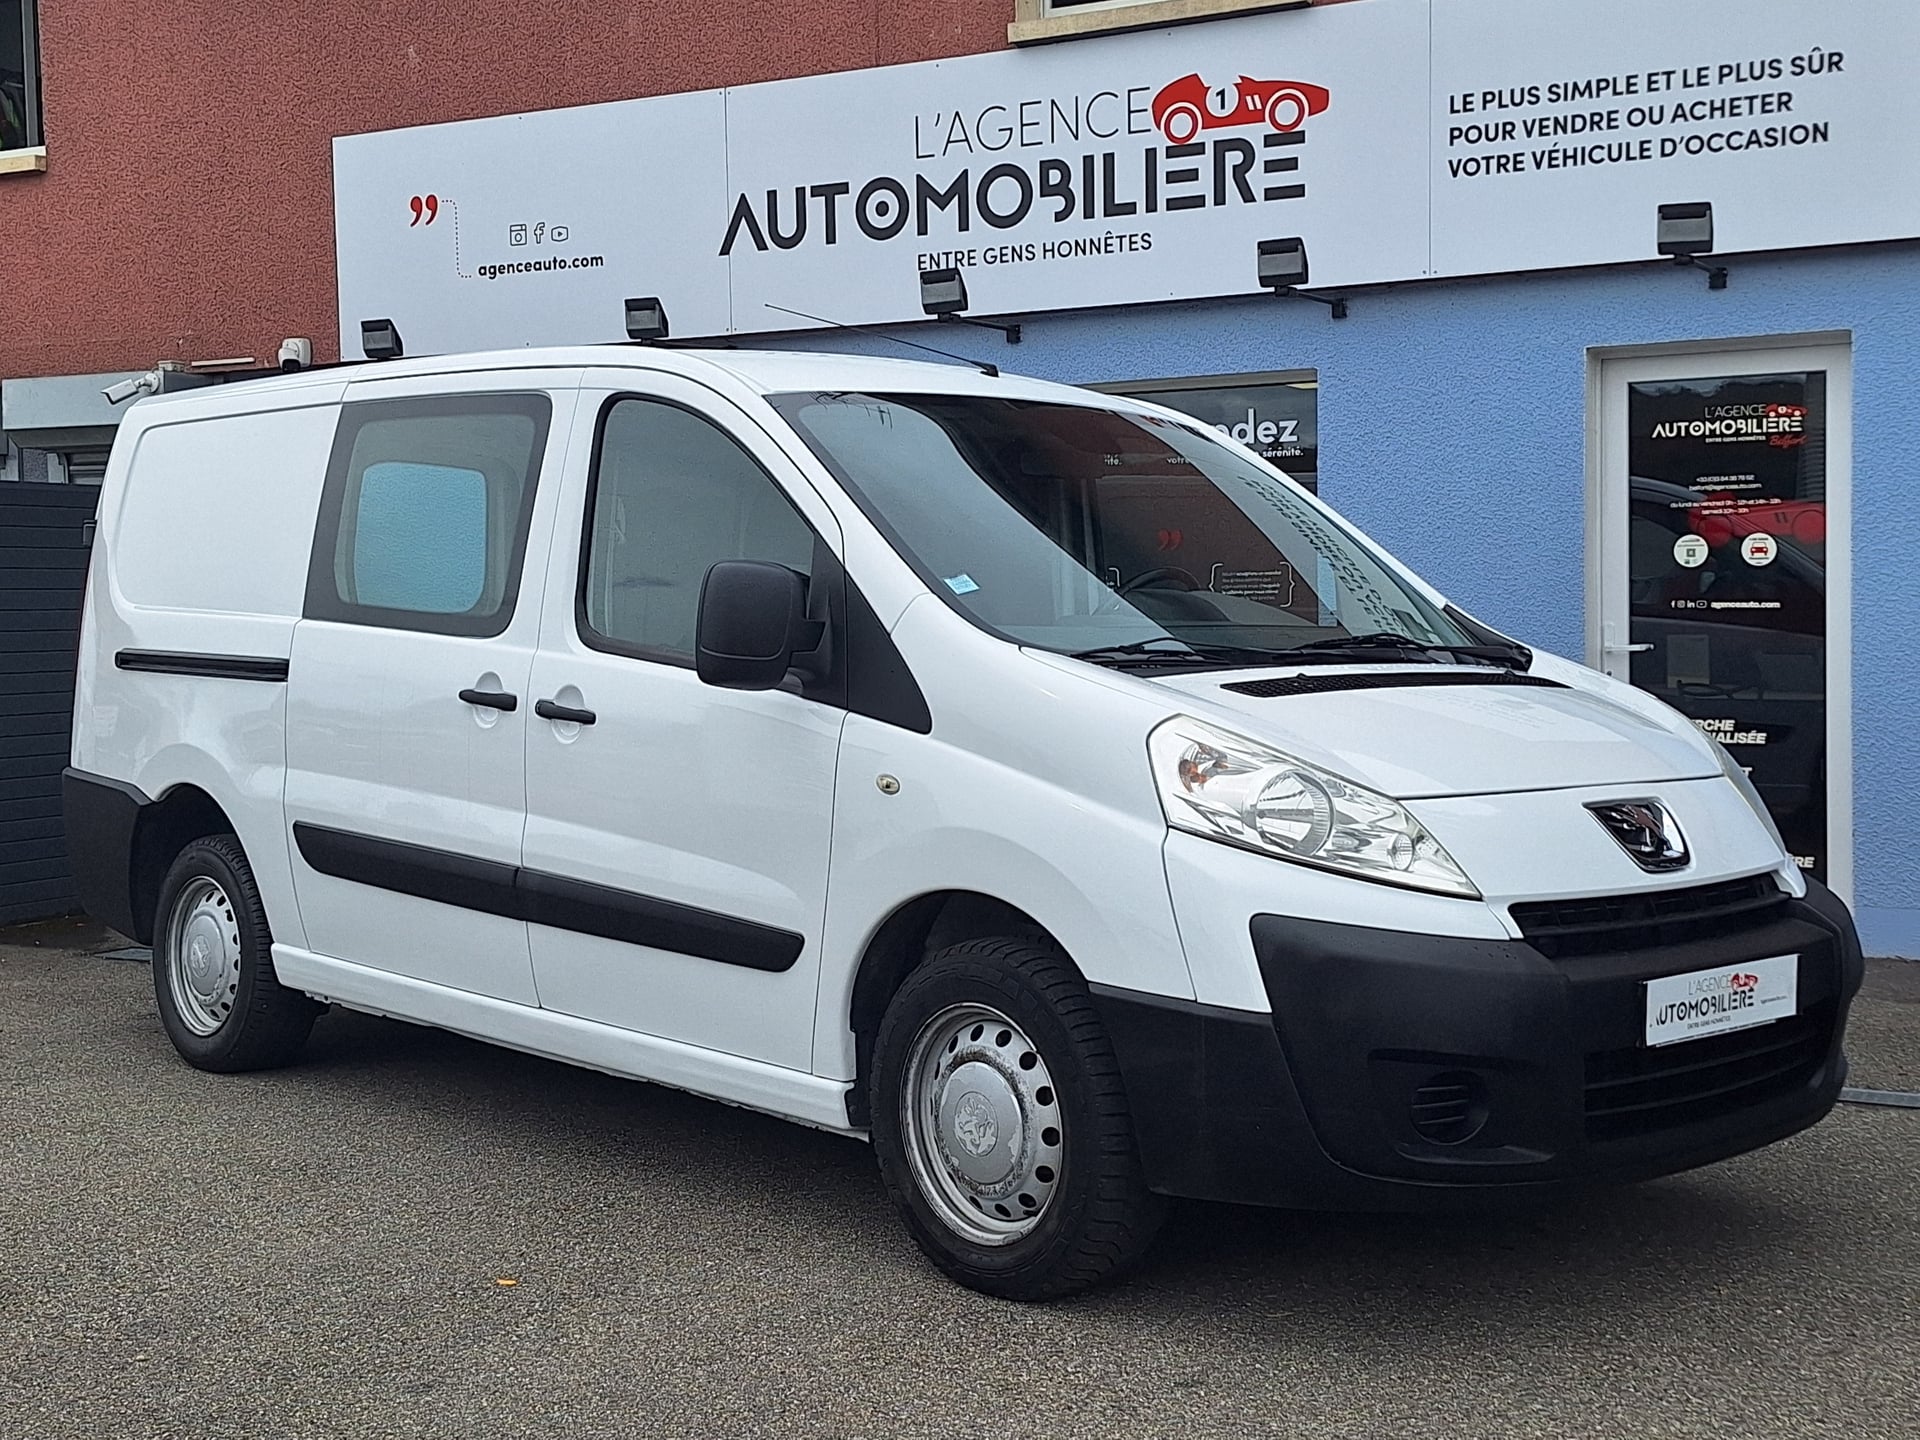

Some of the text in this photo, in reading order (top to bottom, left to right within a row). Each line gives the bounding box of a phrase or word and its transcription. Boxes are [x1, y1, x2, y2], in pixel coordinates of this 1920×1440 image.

[1449, 46, 1845, 115] LE PLUS SIMPLE ET LE PLUS SÛR
[915, 86, 1153, 160] L'AGENCE
[1449, 91, 1794, 147] POUR VENDRE OU ACHETER
[1448, 122, 1830, 178] VOTRE VÉHICULE D'OCCASION
[478, 256, 604, 280] agenceauto.com
[917, 231, 1153, 272] ENTRE GENS HONNÊTES
[1705, 404, 1767, 418] L'AGENCE
[1263, 446, 1304, 458] sérénité.
